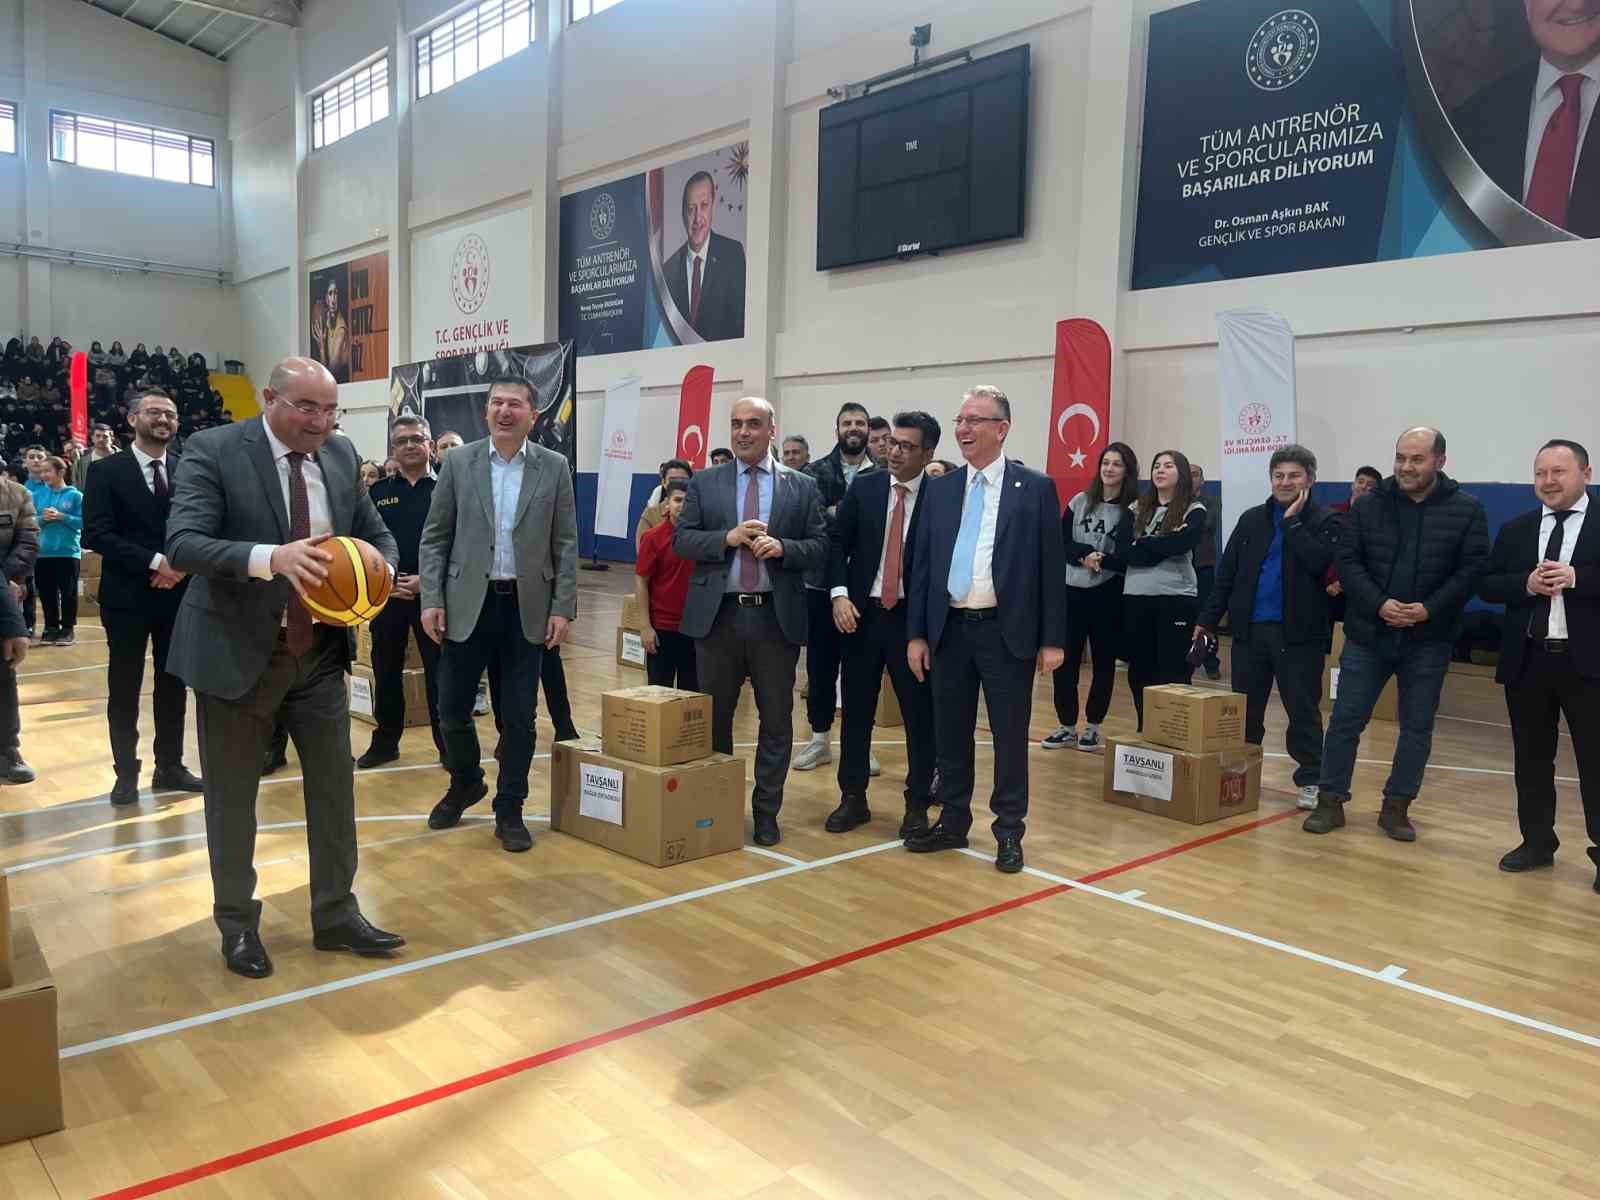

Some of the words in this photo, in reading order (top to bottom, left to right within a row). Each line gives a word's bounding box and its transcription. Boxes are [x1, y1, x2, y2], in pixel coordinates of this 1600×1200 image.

[1200, 129, 1242, 154] TÜM
[1247, 103, 1361, 145] ANTRENÖR
[1177, 158, 1200, 179] VE
[1204, 122, 1384, 175] SPORCULARIMIZA
[1182, 168, 1271, 198] BAŞARILAR
[1274, 149, 1375, 181] DİLİYORUM
[1198, 229, 1246, 248] GENÇLİK
[1247, 227, 1263, 240] VE
[1264, 222, 1297, 239] SPOR
[1298, 215, 1346, 233] BAKANI
[1214, 219, 1230, 230] Dr.
[1231, 213, 1269, 227] Osman
[1271, 207, 1302, 222] Aşkın
[1304, 201, 1330, 215] BAK
[436, 329, 451, 344] T.C.
[453, 319, 493, 342] GENÇLİK
[496, 319, 509, 335] VE
